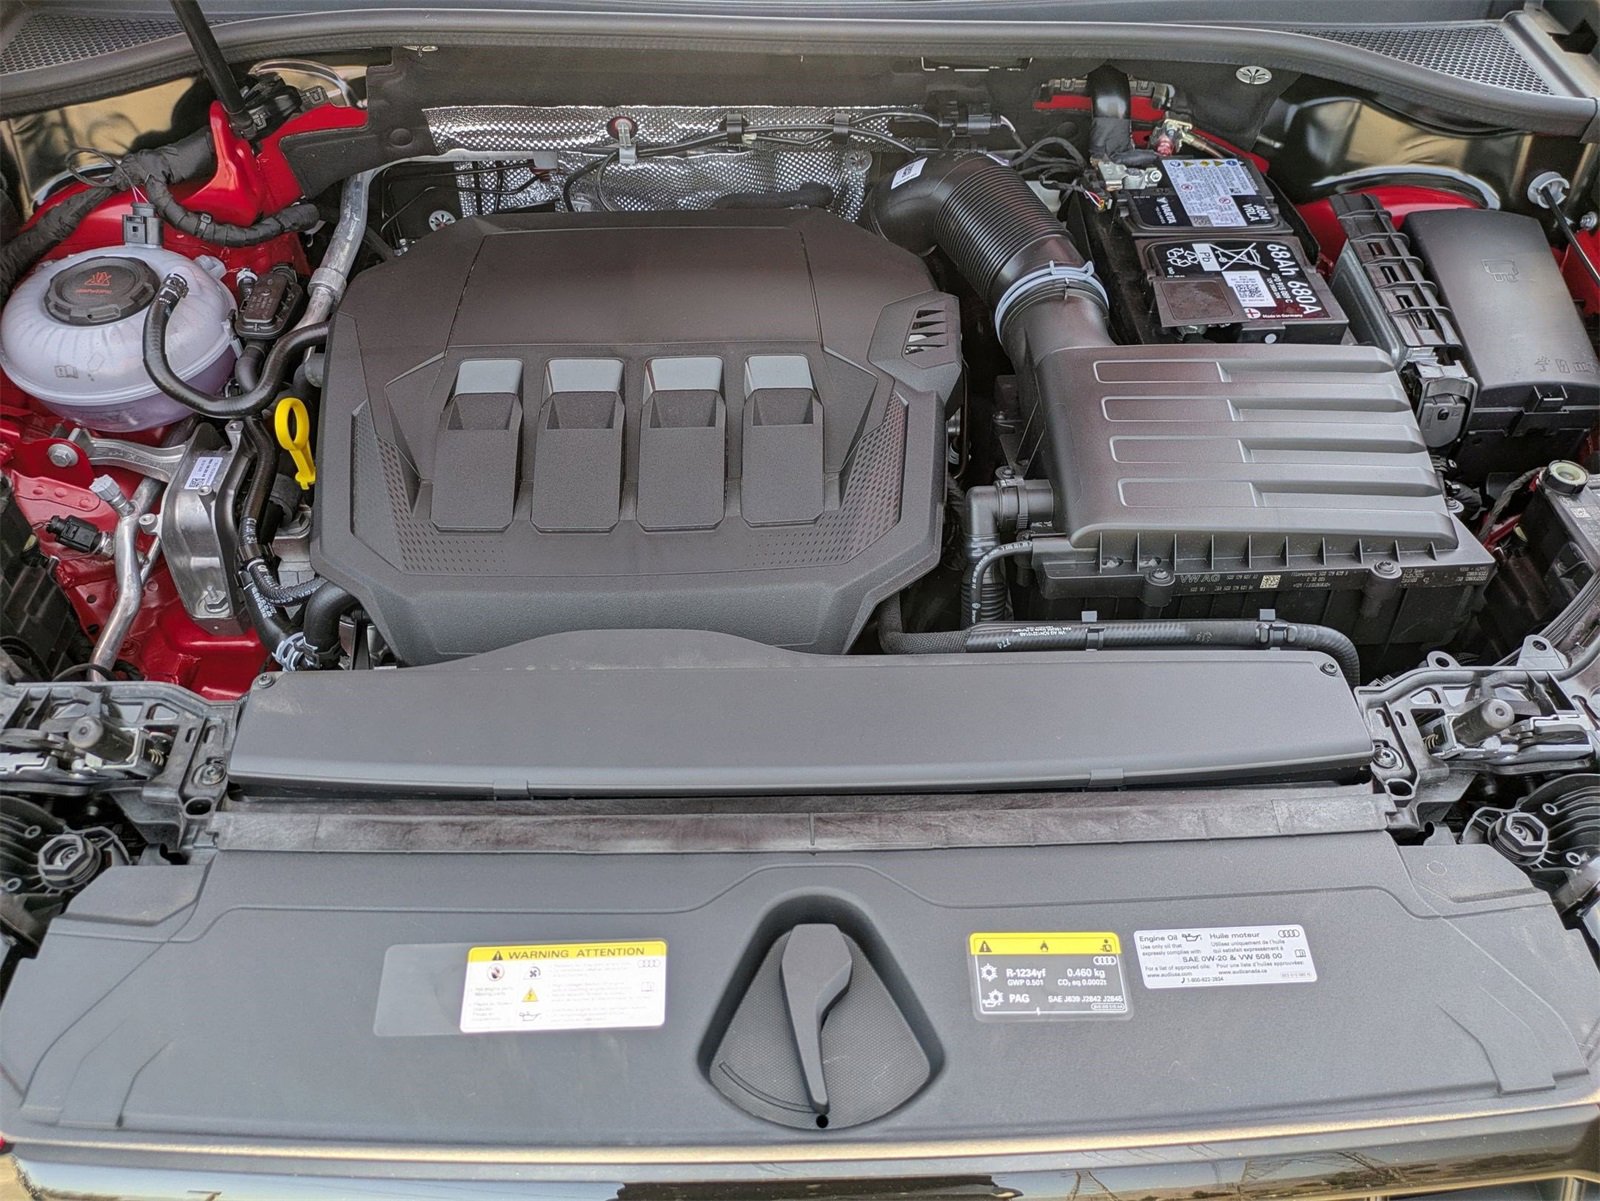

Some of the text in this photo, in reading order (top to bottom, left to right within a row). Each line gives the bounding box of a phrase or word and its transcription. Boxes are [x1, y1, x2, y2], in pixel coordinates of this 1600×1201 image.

[1160, 203, 1177, 224] VARTA
[1242, 203, 1260, 222] VRLA
[1199, 251, 1212, 263] Pb
[1266, 243, 1322, 314] 68Ah 680A
[1180, 574, 1200, 584] VW
[1201, 574, 1221, 583] AG
[1138, 935, 1165, 943] Engine
[508, 947, 645, 960] WARNING ATTENTION
[1182, 955, 1200, 963] SAE
[1201, 954, 1228, 962] 0W-20
[1006, 967, 1106, 979] R-1234yf 0.460 kg
[1009, 993, 1030, 1004] PAG
[1048, 995, 1063, 1003] SAE
